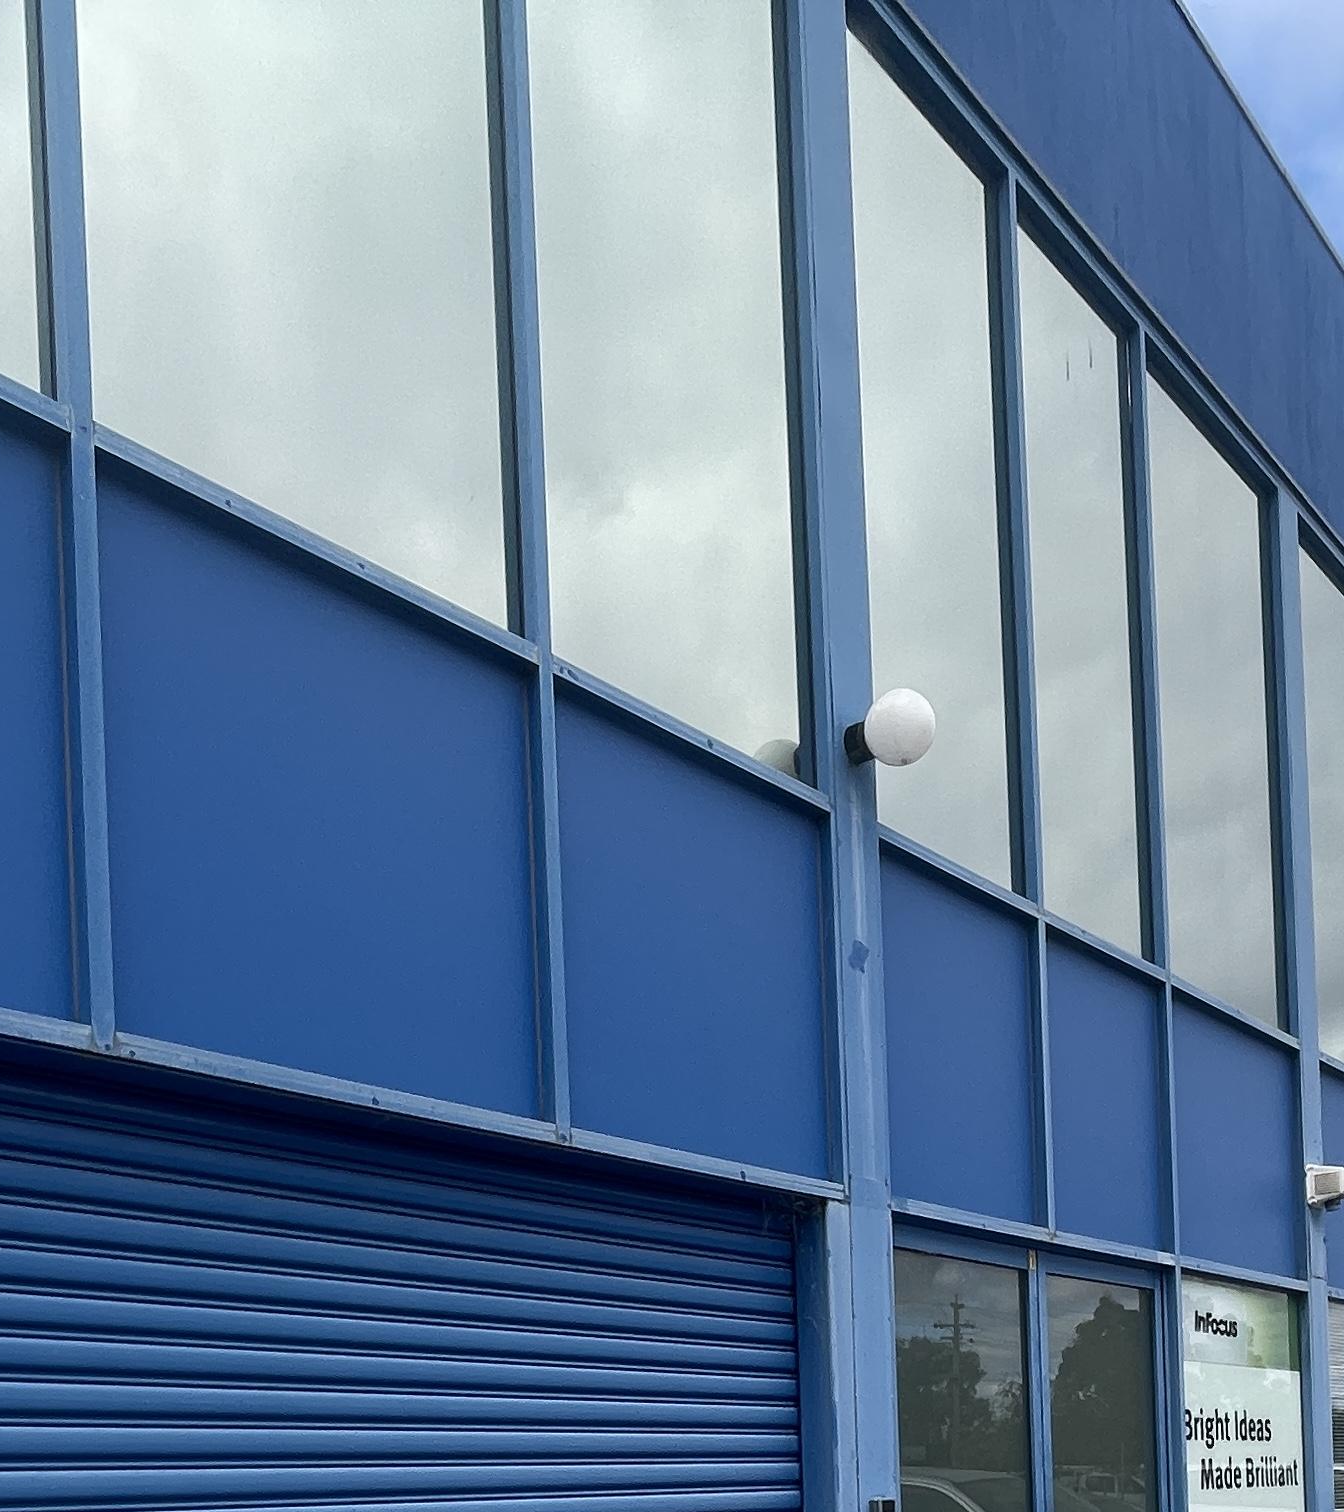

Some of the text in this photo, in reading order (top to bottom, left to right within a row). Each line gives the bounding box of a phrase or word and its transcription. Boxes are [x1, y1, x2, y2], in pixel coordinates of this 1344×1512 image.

[1194, 1309, 1238, 1338] InFocus
[1184, 1408, 1272, 1449] Bright Ideas
[1200, 1456, 1299, 1490] Made Brilliant
